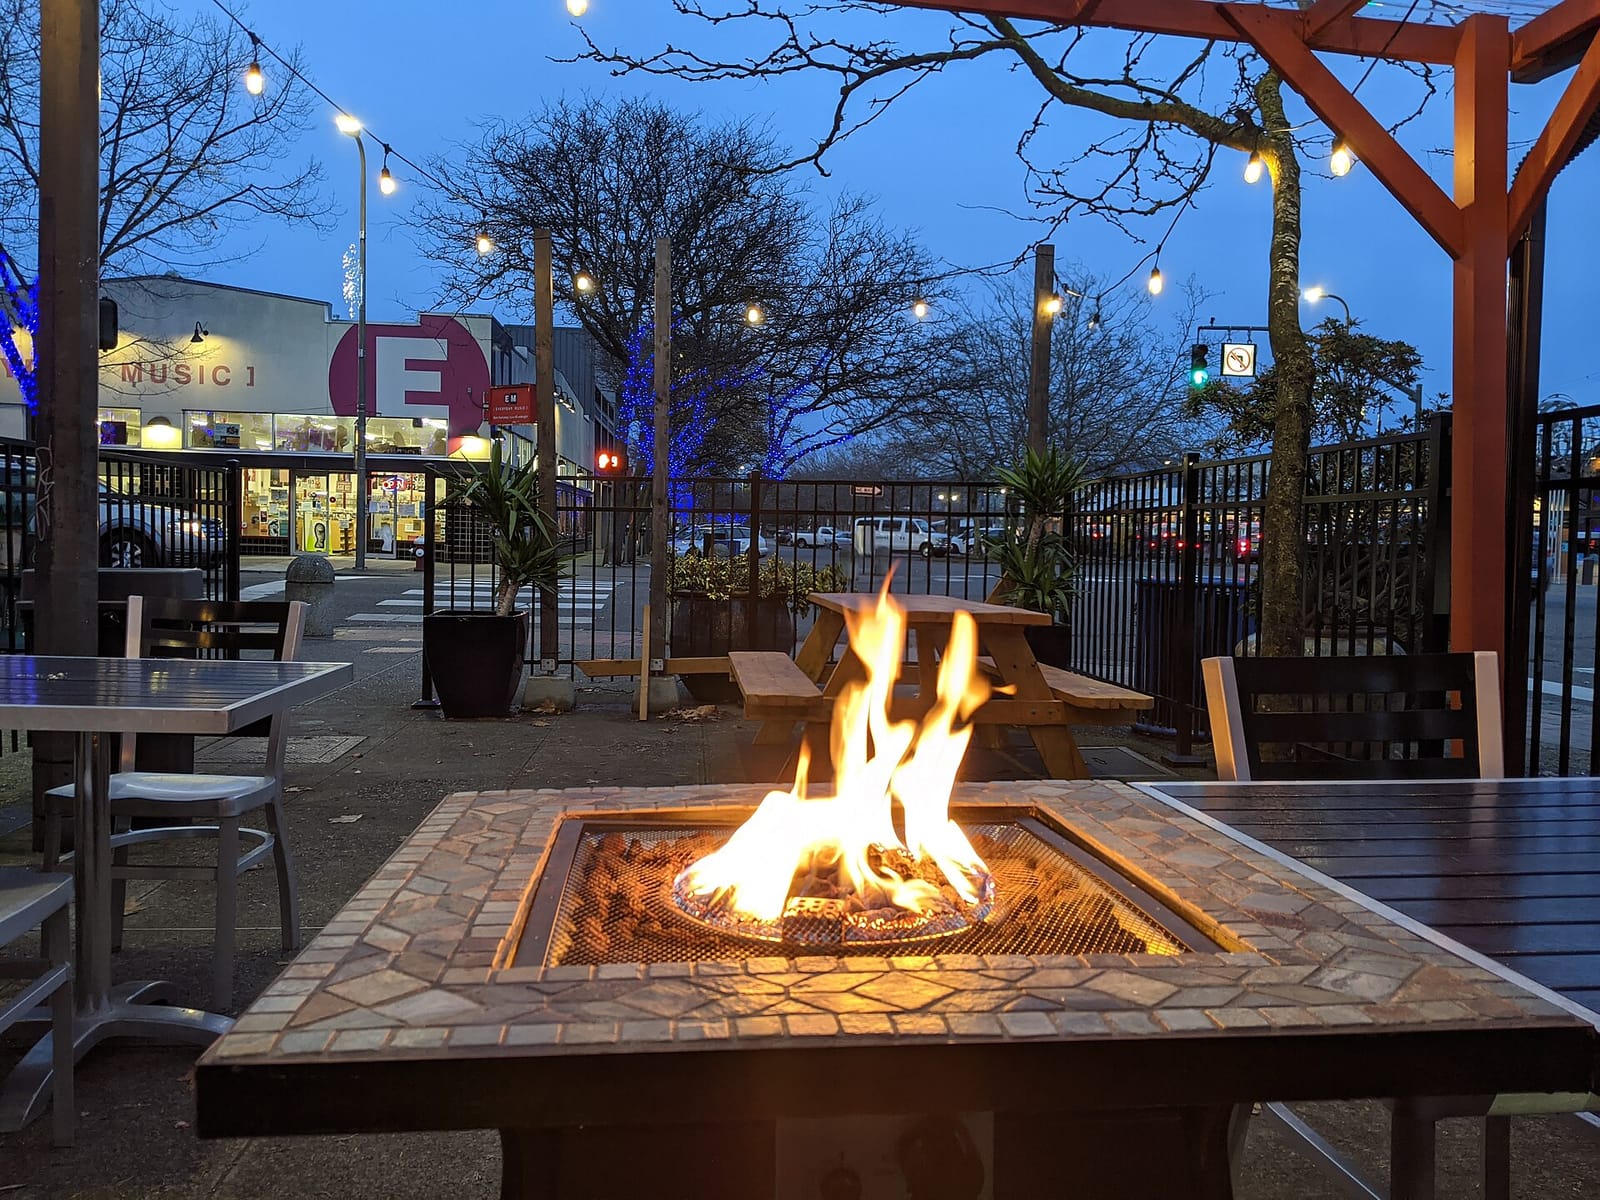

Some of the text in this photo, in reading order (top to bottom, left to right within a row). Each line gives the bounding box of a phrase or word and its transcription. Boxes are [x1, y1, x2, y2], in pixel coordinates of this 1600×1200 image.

[121, 362, 232, 386] MUSIC
[376, 336, 449, 419] E
[611, 455, 618, 468] 9
[382, 480, 404, 489] OPN
